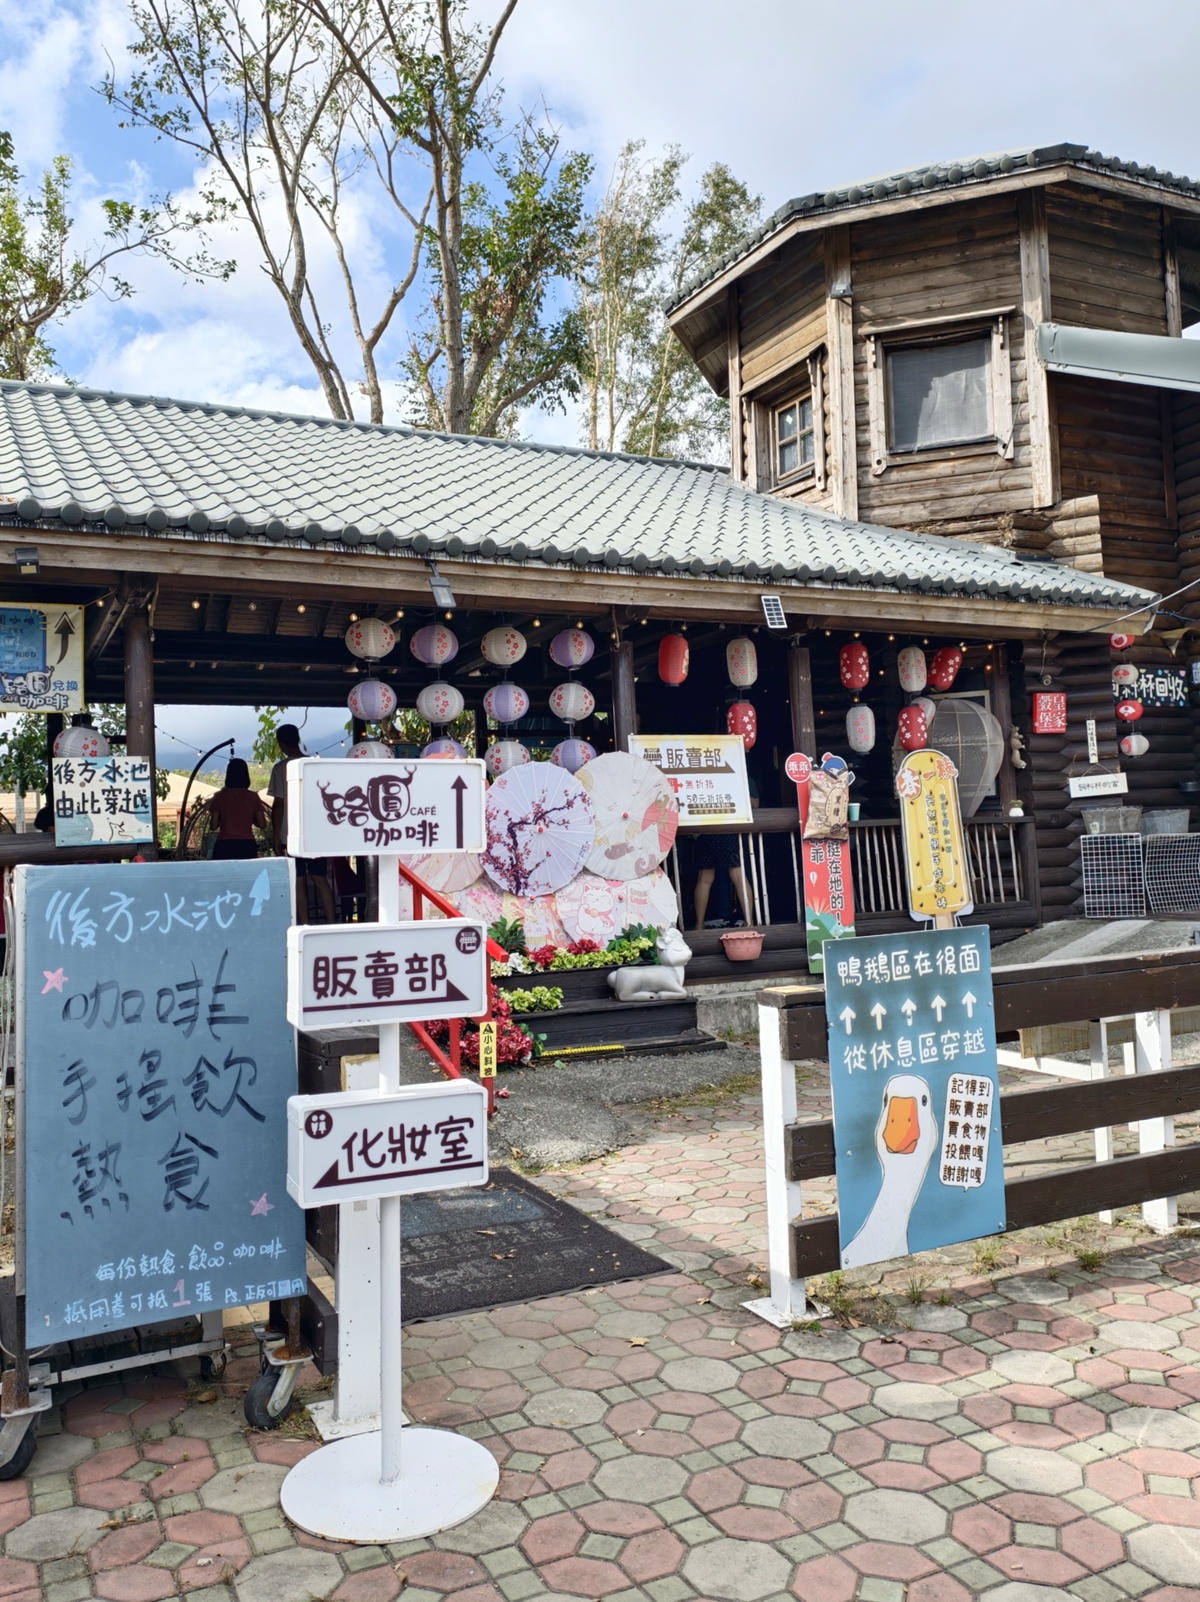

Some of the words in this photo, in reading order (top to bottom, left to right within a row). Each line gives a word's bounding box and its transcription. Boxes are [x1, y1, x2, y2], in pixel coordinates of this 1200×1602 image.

[20, 693, 69, 710] 咖啡
[54, 759, 150, 784] 後方水池
[667, 747, 721, 767] 販賣部
[788, 761, 809, 773] 乖乖
[56, 785, 149, 818] 由此穿越
[317, 767, 415, 826] 路圓
[410, 805, 437, 816] CAFÉ
[363, 821, 440, 848] 咖啡
[45, 887, 242, 948] 後方水池
[313, 951, 447, 1000] 販賣部
[837, 944, 980, 987] 鴨鵝區在後面
[62, 949, 249, 1042] 咖啡
[843, 1027, 986, 1075] 從休息區穿越
[951, 1078, 990, 1097] 記得到
[948, 1099, 988, 1118] 販賣部
[341, 1116, 475, 1173] 化妝室
[948, 1121, 987, 1140] 買食物
[60, 1131, 219, 1226] 熱食
